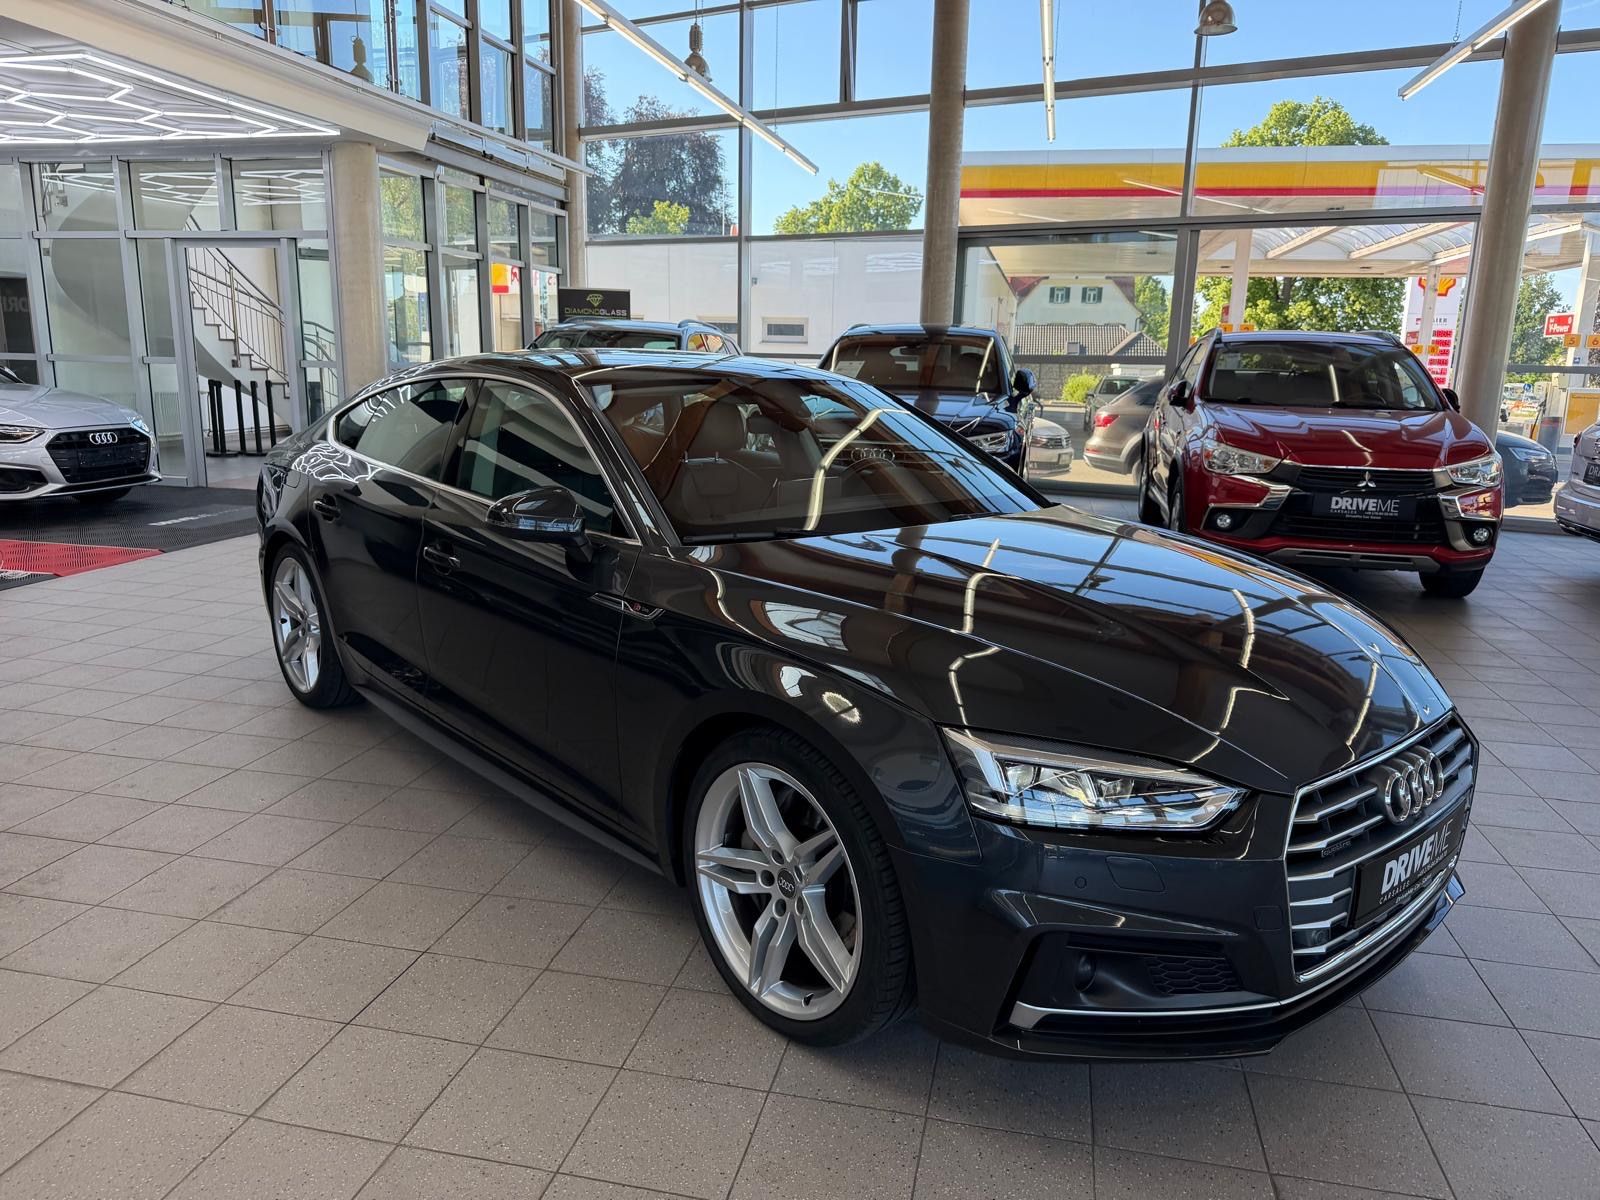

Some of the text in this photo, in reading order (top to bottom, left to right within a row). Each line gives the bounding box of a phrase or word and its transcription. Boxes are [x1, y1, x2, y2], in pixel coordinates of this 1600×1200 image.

[564, 307, 627, 316] DIAMONDGLASS
[1549, 323, 1570, 333] V-Power
[1569, 337, 1576, 345] 5
[1592, 337, 1599, 345] 6
[1330, 496, 1400, 513] DRIVEME
[1380, 818, 1454, 895] DRIVEME
[1378, 880, 1411, 905] CARSALES
